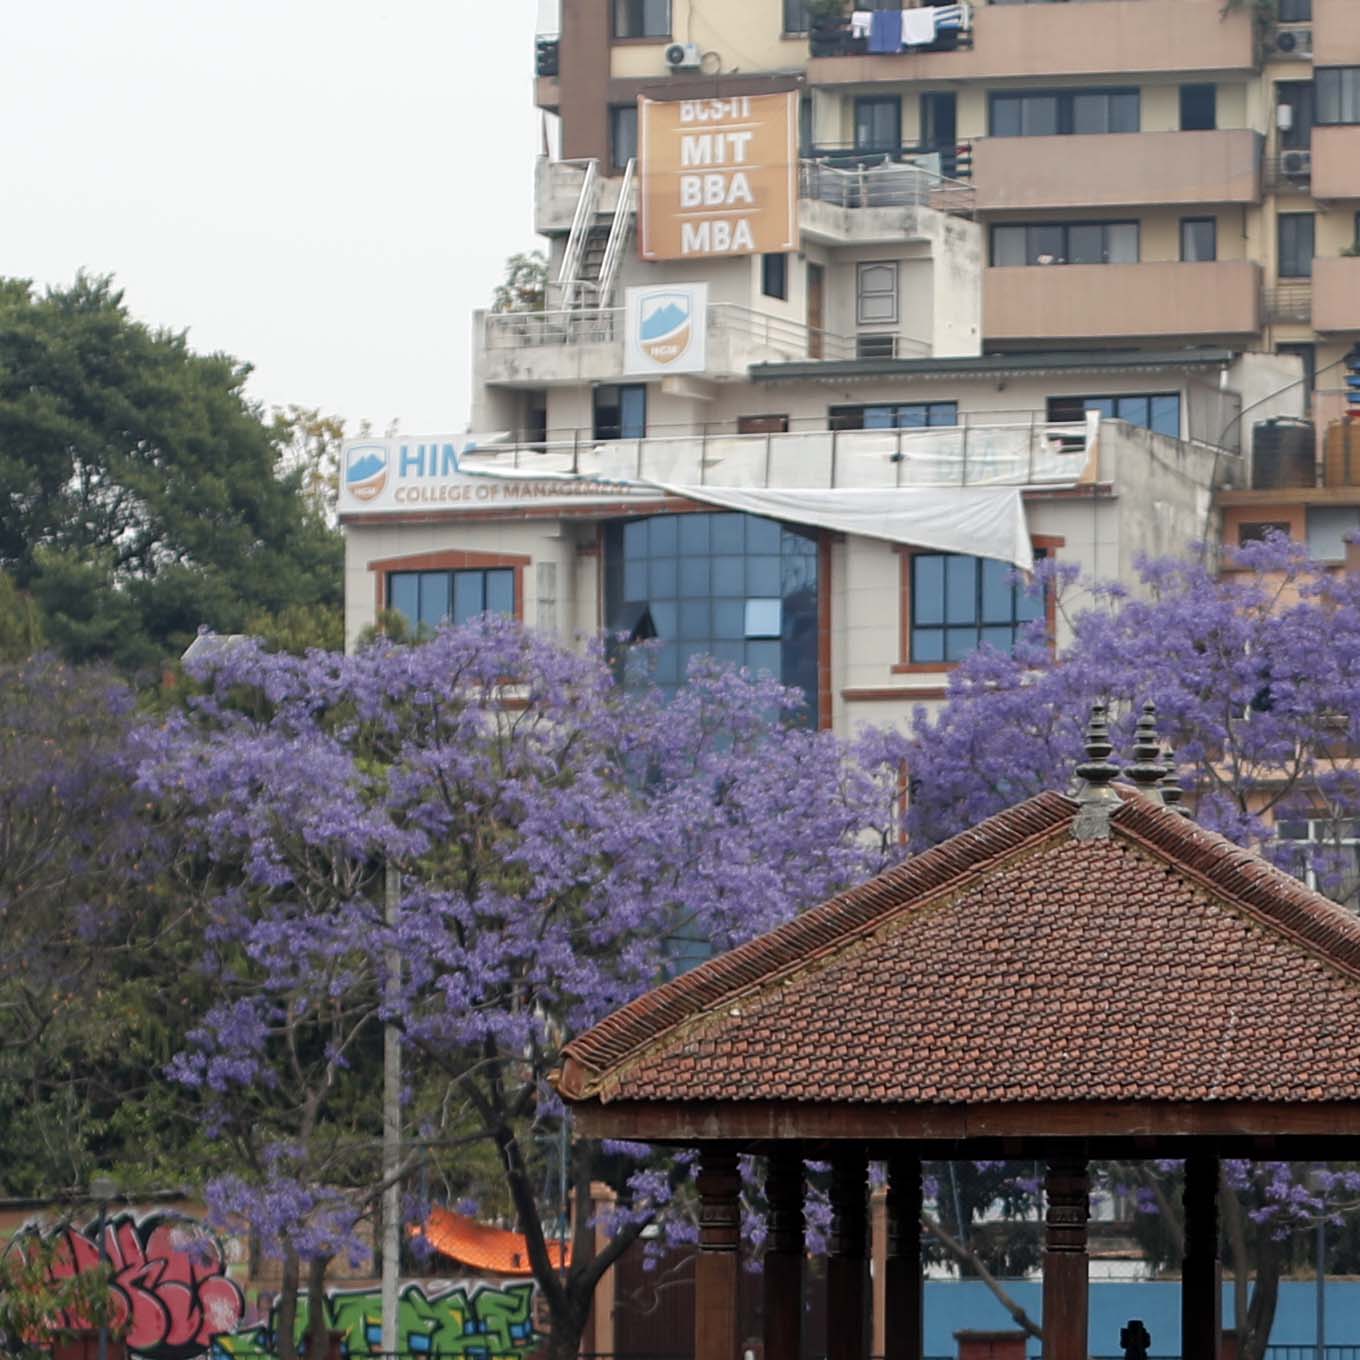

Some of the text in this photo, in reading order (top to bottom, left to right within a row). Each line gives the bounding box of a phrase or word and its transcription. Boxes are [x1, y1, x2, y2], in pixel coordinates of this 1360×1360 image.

[680, 131, 752, 166] MIT
[680, 173, 753, 208] BBA
[681, 219, 754, 255] MBA
[395, 483, 472, 504] COLLEGE
[478, 483, 498, 501] OF
